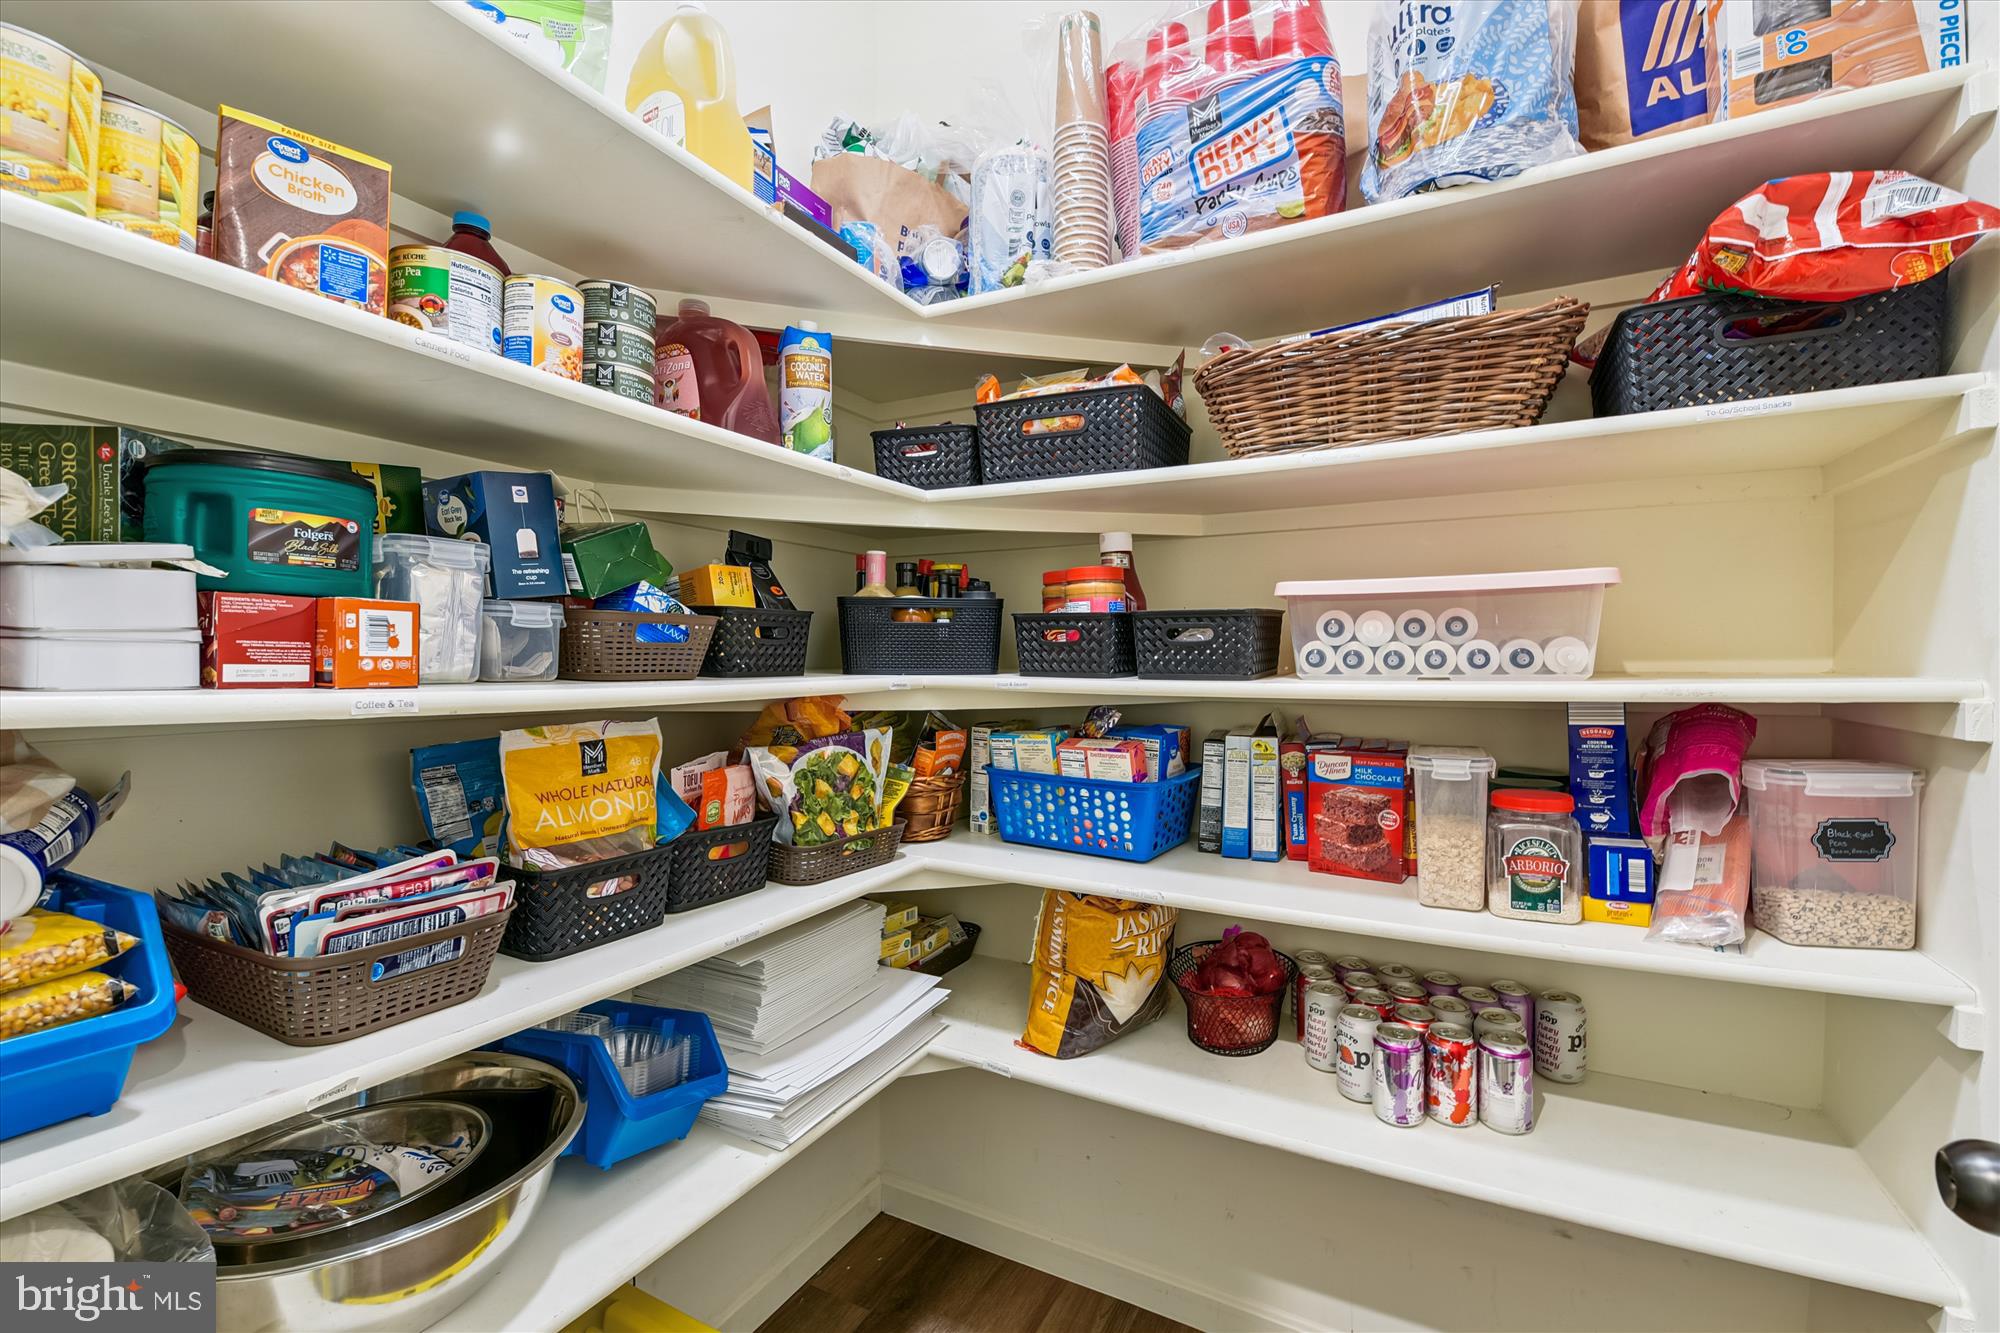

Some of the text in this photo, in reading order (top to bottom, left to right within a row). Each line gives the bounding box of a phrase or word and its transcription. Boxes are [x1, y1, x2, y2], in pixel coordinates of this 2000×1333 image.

[1415, 26, 1451, 37] plates
[1785, 28, 1808, 55] 60
[1646, 66, 1707, 107] AL
[318, 140, 337, 151] SIZE
[1198, 111, 1276, 168] HEAVY
[272, 140, 302, 156] Great
[280, 149, 302, 161] Value
[1204, 140, 1279, 186] DUTY
[268, 163, 345, 198] Chicken
[287, 183, 327, 204] Broth
[405, 267, 421, 277] Pea
[451, 261, 492, 280] Nutrition Facts
[450, 285, 492, 303] Calories 170
[633, 308, 656, 325] CHICK
[415, 337, 448, 355] Canned
[621, 346, 653, 363] CHICKEN
[790, 362, 827, 373] COCONUT
[795, 371, 825, 382] WATER
[1705, 400, 1793, 417] To Go/School Snacks
[38, 442, 56, 529] Gree Te
[61, 442, 77, 542] ORGANIC
[102, 463, 113, 523] Uncle Lee's
[451, 507, 462, 515] Grey
[293, 527, 334, 541] Folgers
[284, 539, 339, 555] Black Silk
[355, 699, 414, 710] Coffee & Tea
[1090, 752, 1127, 760] bettergoods
[1318, 760, 1348, 769] Duncan
[683, 774, 698, 787] TOFU
[1354, 773, 1401, 783] CHOCOLATE
[534, 785, 589, 805] WHOLE
[1515, 839, 1557, 857] RICESELECT
[1828, 839, 1848, 847] Peas
[1508, 861, 1564, 874] ARBORIO
[1135, 923, 1172, 957] RIC
[1308, 1005, 1325, 1016] pop
[1539, 1013, 1557, 1025] pop
[1307, 1029, 1328, 1043] tangy
[1308, 1022, 1327, 1035] juicy
[1537, 1031, 1559, 1045] juicy
